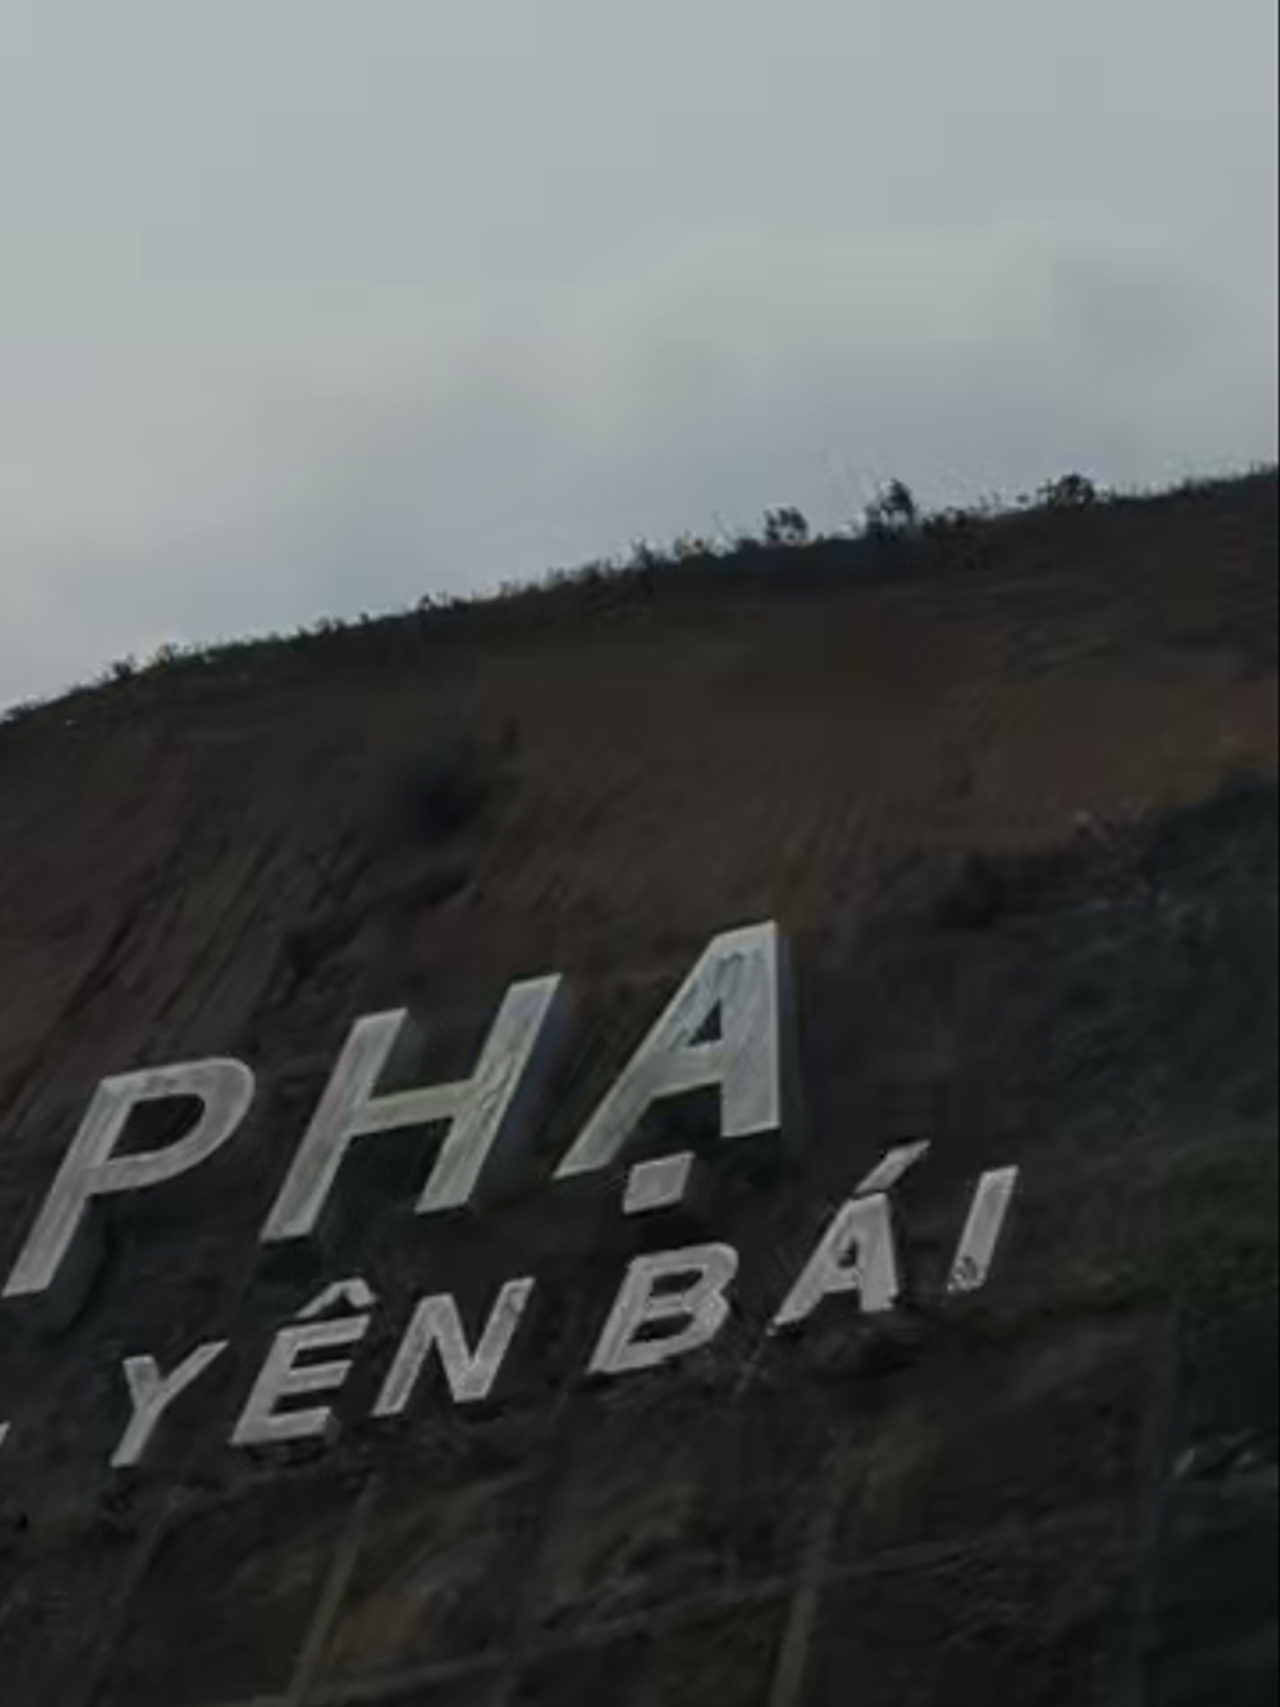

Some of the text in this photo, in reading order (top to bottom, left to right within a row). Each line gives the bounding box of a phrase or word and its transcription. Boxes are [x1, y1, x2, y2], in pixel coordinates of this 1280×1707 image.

[1, 919, 783, 1298] PHẠ
[109, 1277, 536, 1468] YÊN
[586, 1138, 1020, 1377] BÁI
